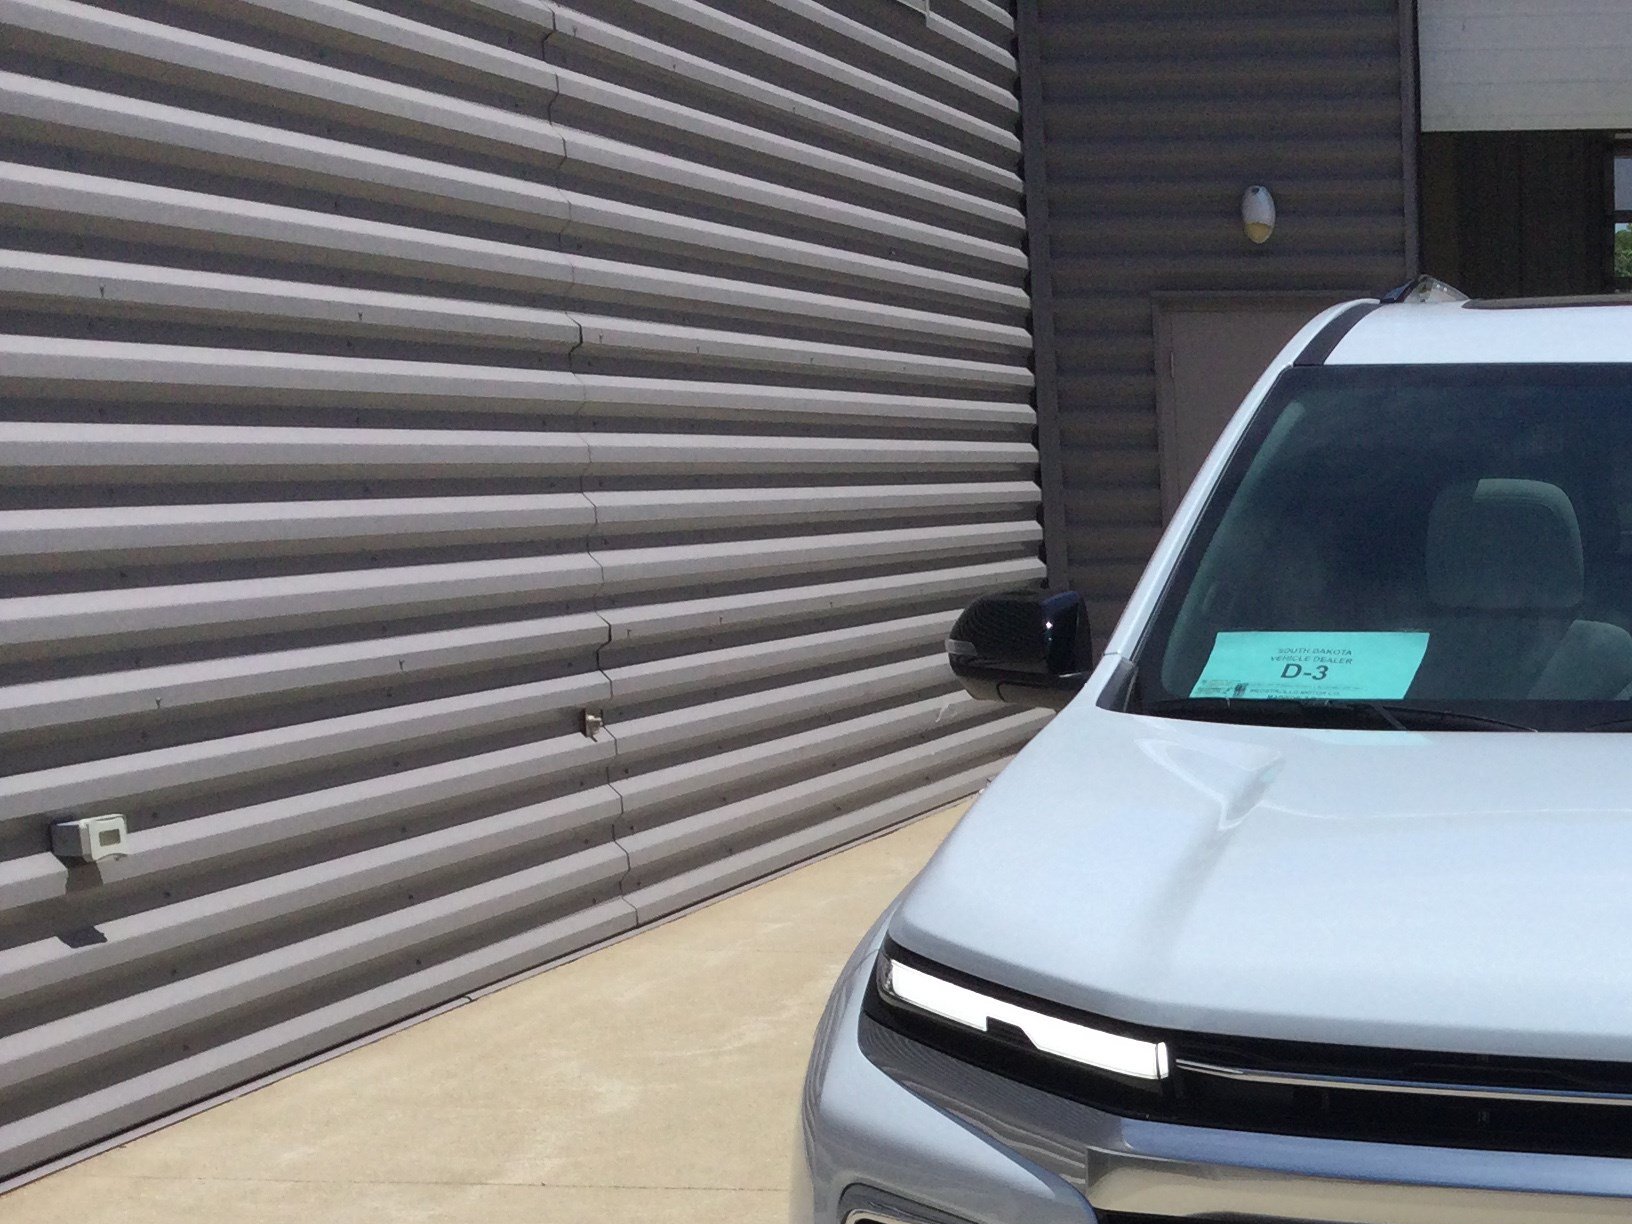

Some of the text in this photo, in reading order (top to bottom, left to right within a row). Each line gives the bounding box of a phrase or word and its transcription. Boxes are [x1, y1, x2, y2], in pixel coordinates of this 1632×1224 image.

[1311, 648, 1353, 656] DAKOTA
[1312, 656, 1353, 665] DEALER
[1280, 663, 1329, 681] D-3
